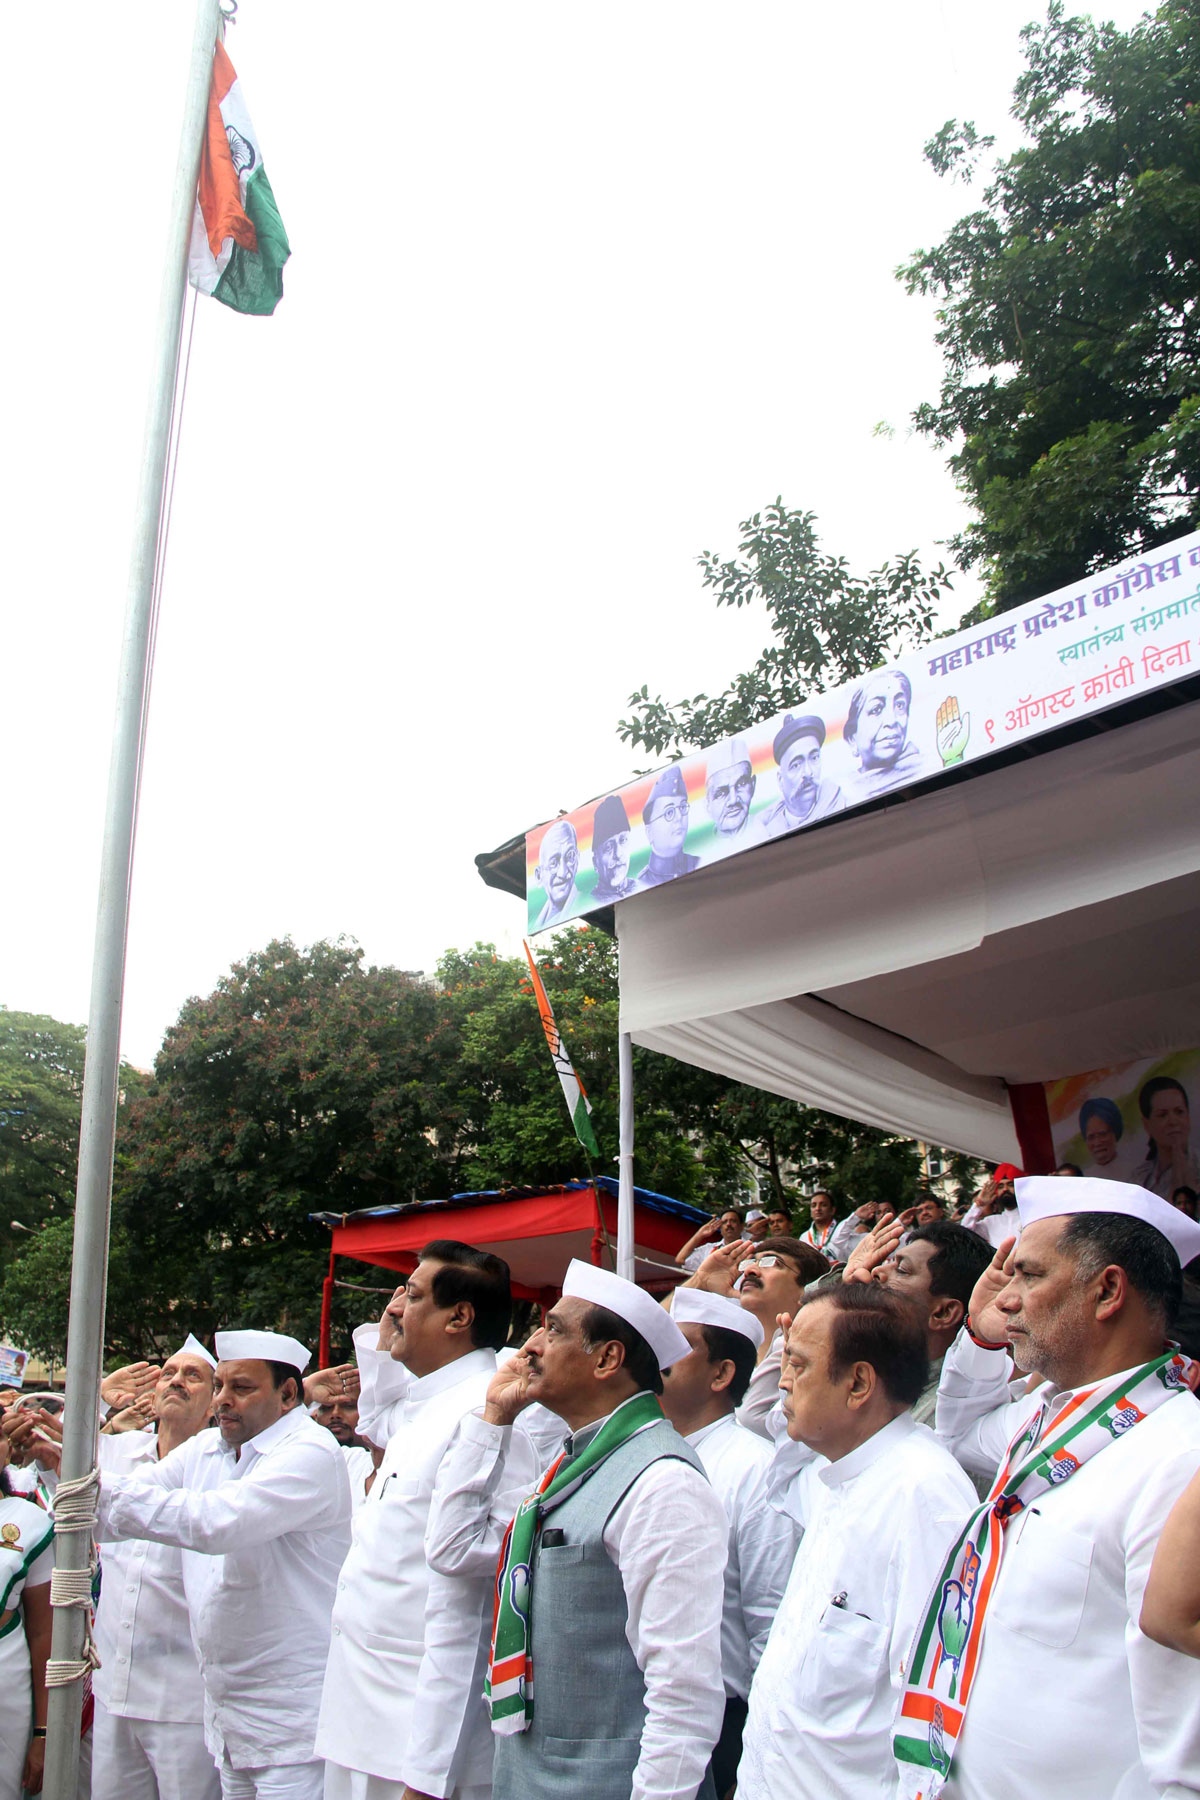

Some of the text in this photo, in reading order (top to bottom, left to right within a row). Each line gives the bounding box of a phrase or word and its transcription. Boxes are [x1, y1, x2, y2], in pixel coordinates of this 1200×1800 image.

[927, 623, 1017, 677] महाराष्ट्र
[1022, 594, 1088, 639] प्रदेश
[1056, 623, 1125, 666] स्वातंत्र्य
[1004, 686, 1076, 732] ऑगस्ट
[1081, 655, 1135, 703] क्रांती
[1141, 639, 1192, 679] दिना
